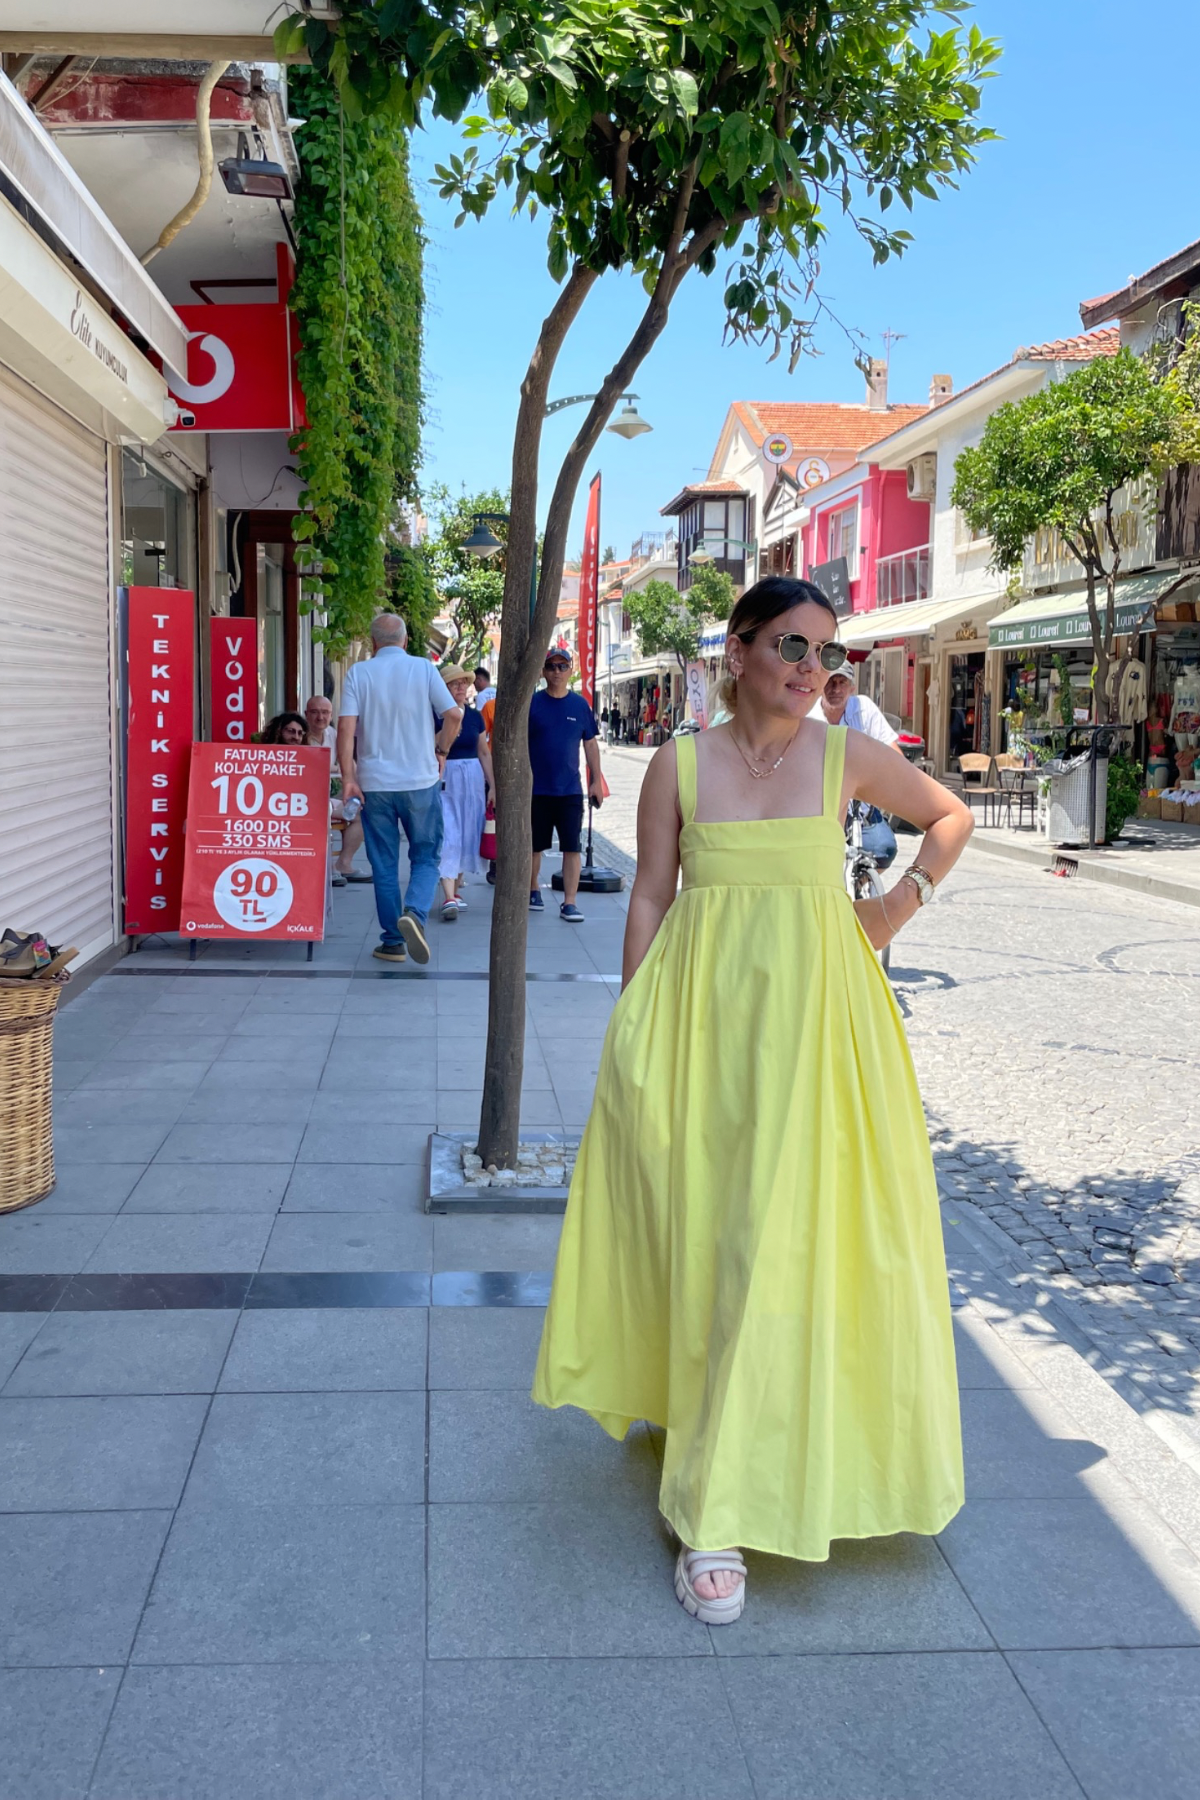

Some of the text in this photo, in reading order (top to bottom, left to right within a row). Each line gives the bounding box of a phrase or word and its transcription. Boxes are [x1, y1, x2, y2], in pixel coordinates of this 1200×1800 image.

[70, 289, 92, 348] Elite
[149, 614, 171, 909] TEKNİK SERVİS
[224, 748, 297, 762] FATURASIZ
[214, 762, 306, 776] KOLAY PAKET
[210, 775, 309, 817] 10 GB
[224, 819, 291, 833] 1600 DK
[222, 833, 291, 848] 330 SMS
[230, 868, 278, 898] 90
[239, 899, 264, 916] TL
